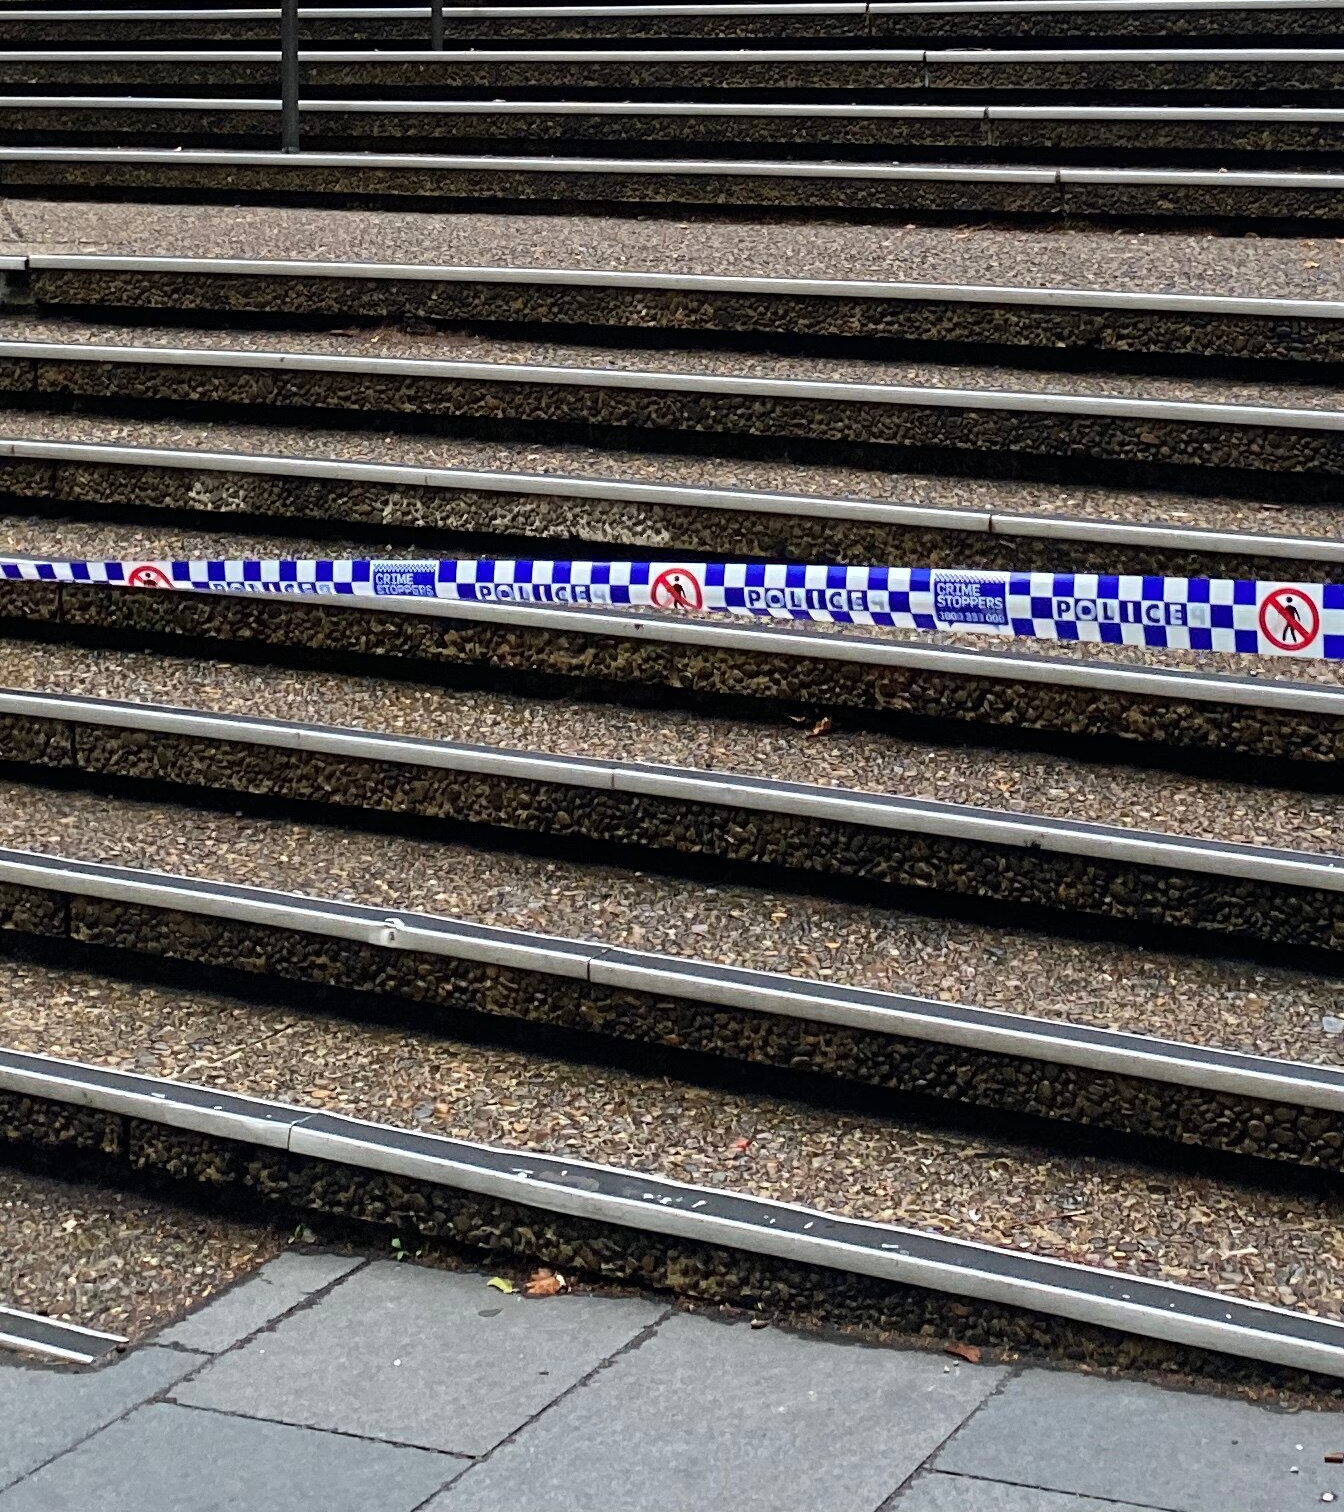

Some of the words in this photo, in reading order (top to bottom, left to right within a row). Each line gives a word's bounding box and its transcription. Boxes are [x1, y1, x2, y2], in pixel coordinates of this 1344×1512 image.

[376, 573, 413, 585] CRIME
[376, 584, 435, 597] STOPPERS
[479, 584, 590, 603] POLICE
[936, 582, 981, 596] CRIME
[747, 588, 864, 611] POLICE
[936, 595, 1003, 609] STOPPERS
[1056, 599, 1183, 626] POLICE
